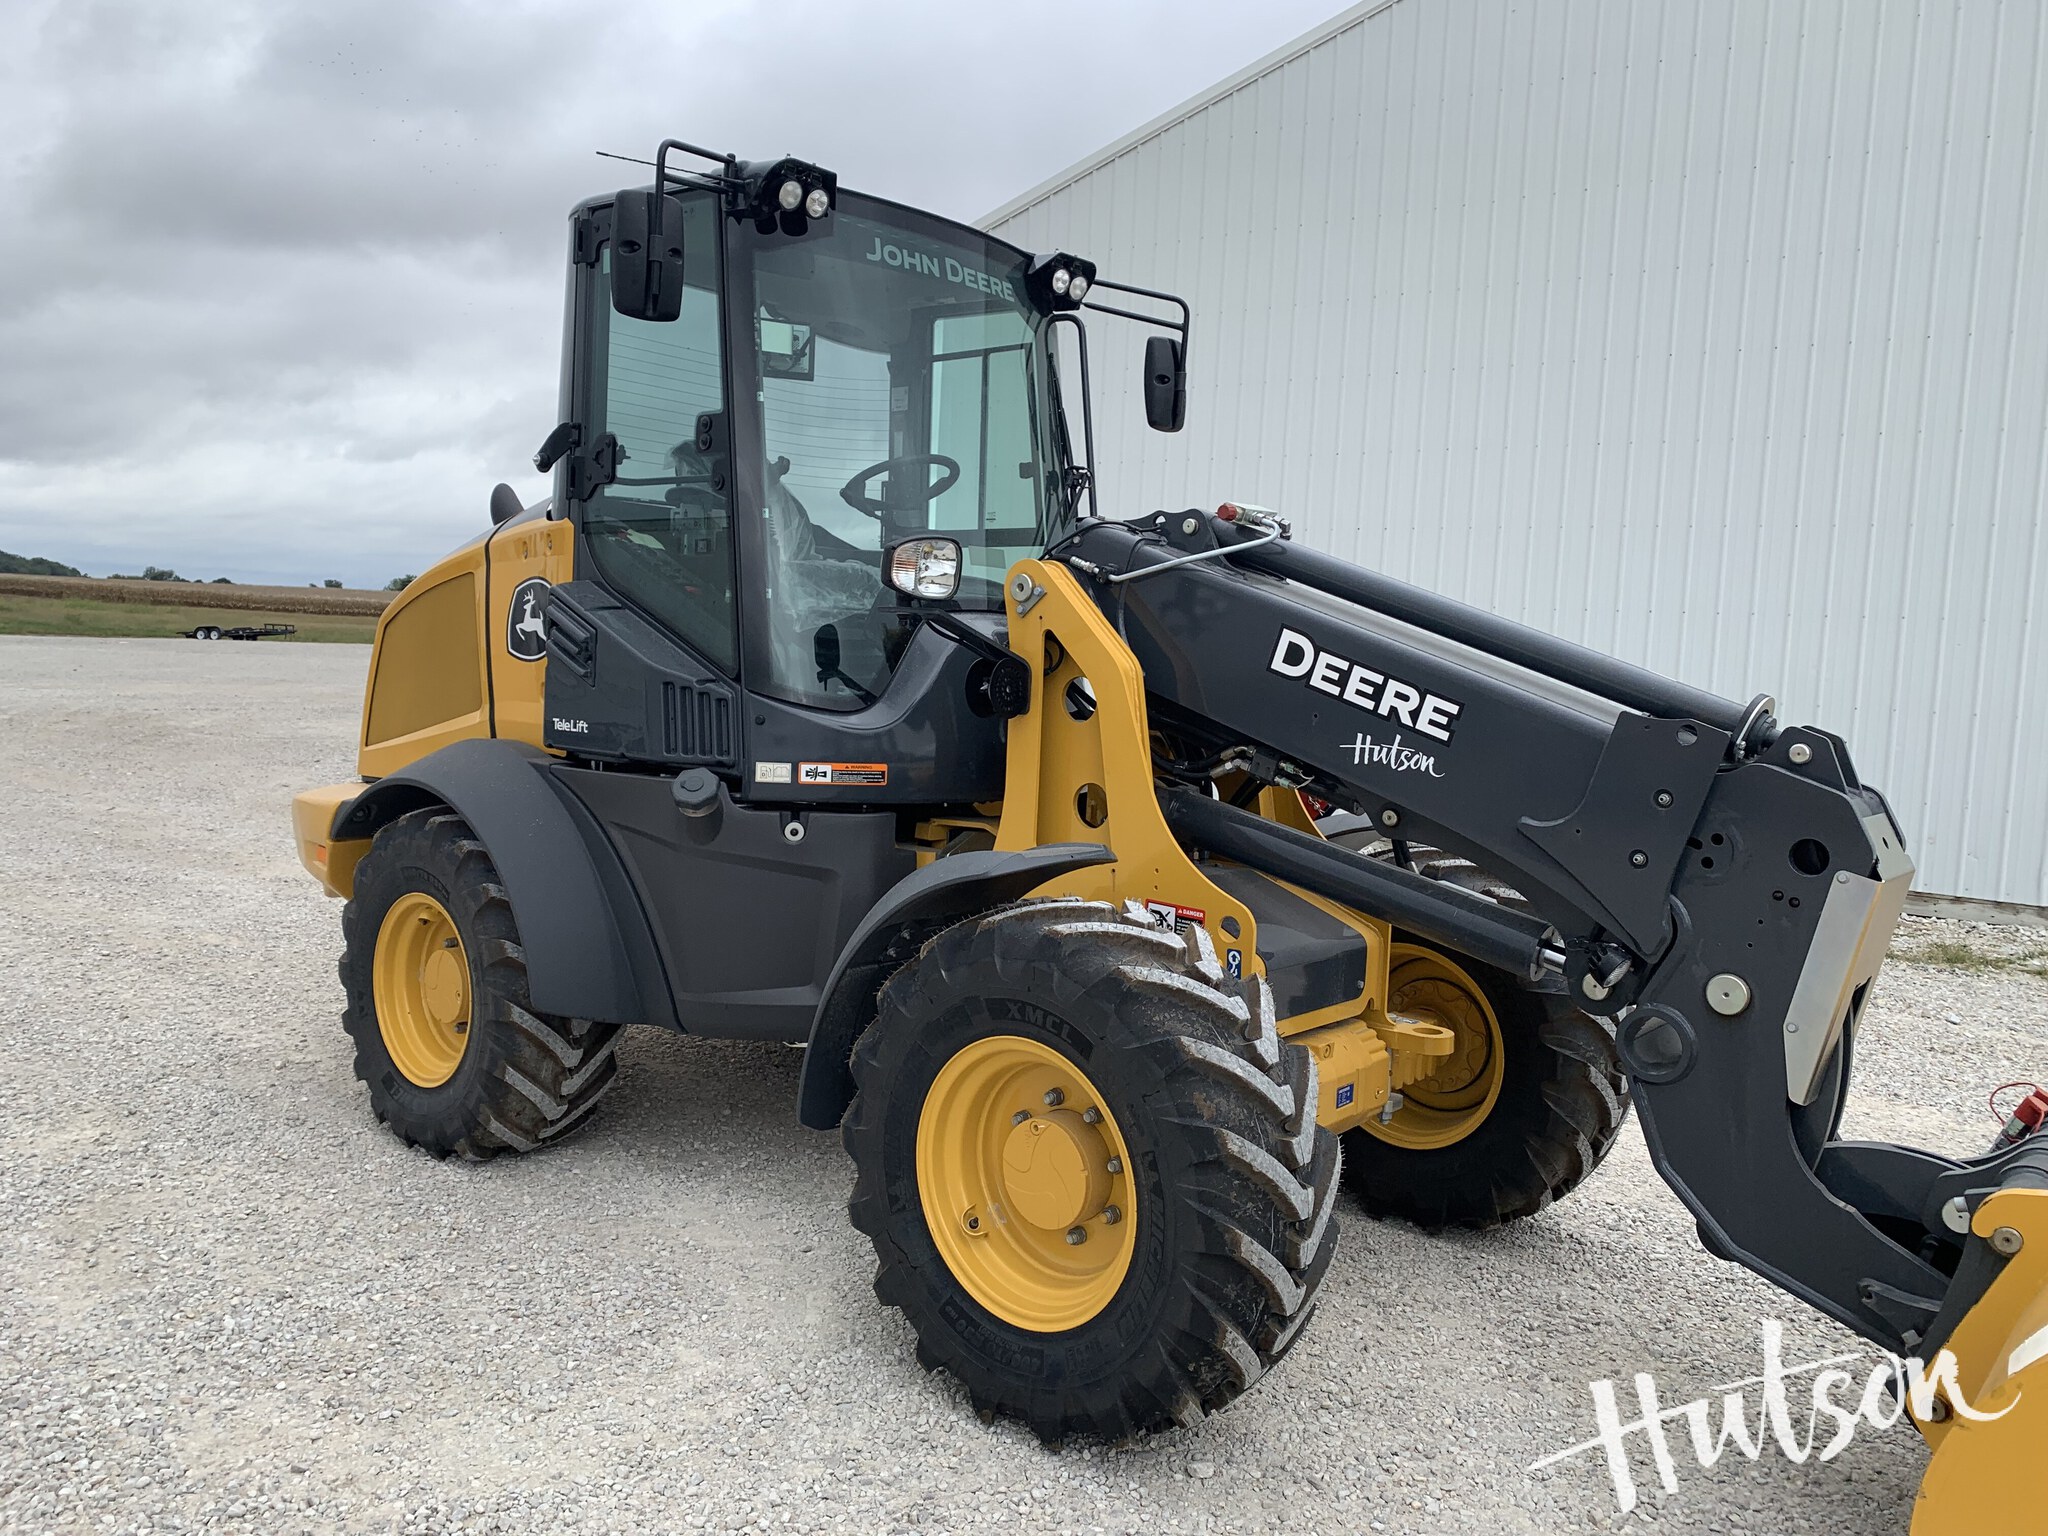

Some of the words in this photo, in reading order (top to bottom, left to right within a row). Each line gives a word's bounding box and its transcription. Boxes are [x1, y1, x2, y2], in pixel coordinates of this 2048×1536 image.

[866, 237, 940, 278] JOHN
[945, 256, 1015, 302] DEERE
[1270, 627, 1460, 742] DEERE
[552, 717, 589, 733] TeleLift
[1339, 732, 1446, 778] Hutson
[1182, 908, 1204, 918] DANGER
[1006, 1001, 1072, 1043] XMCL
